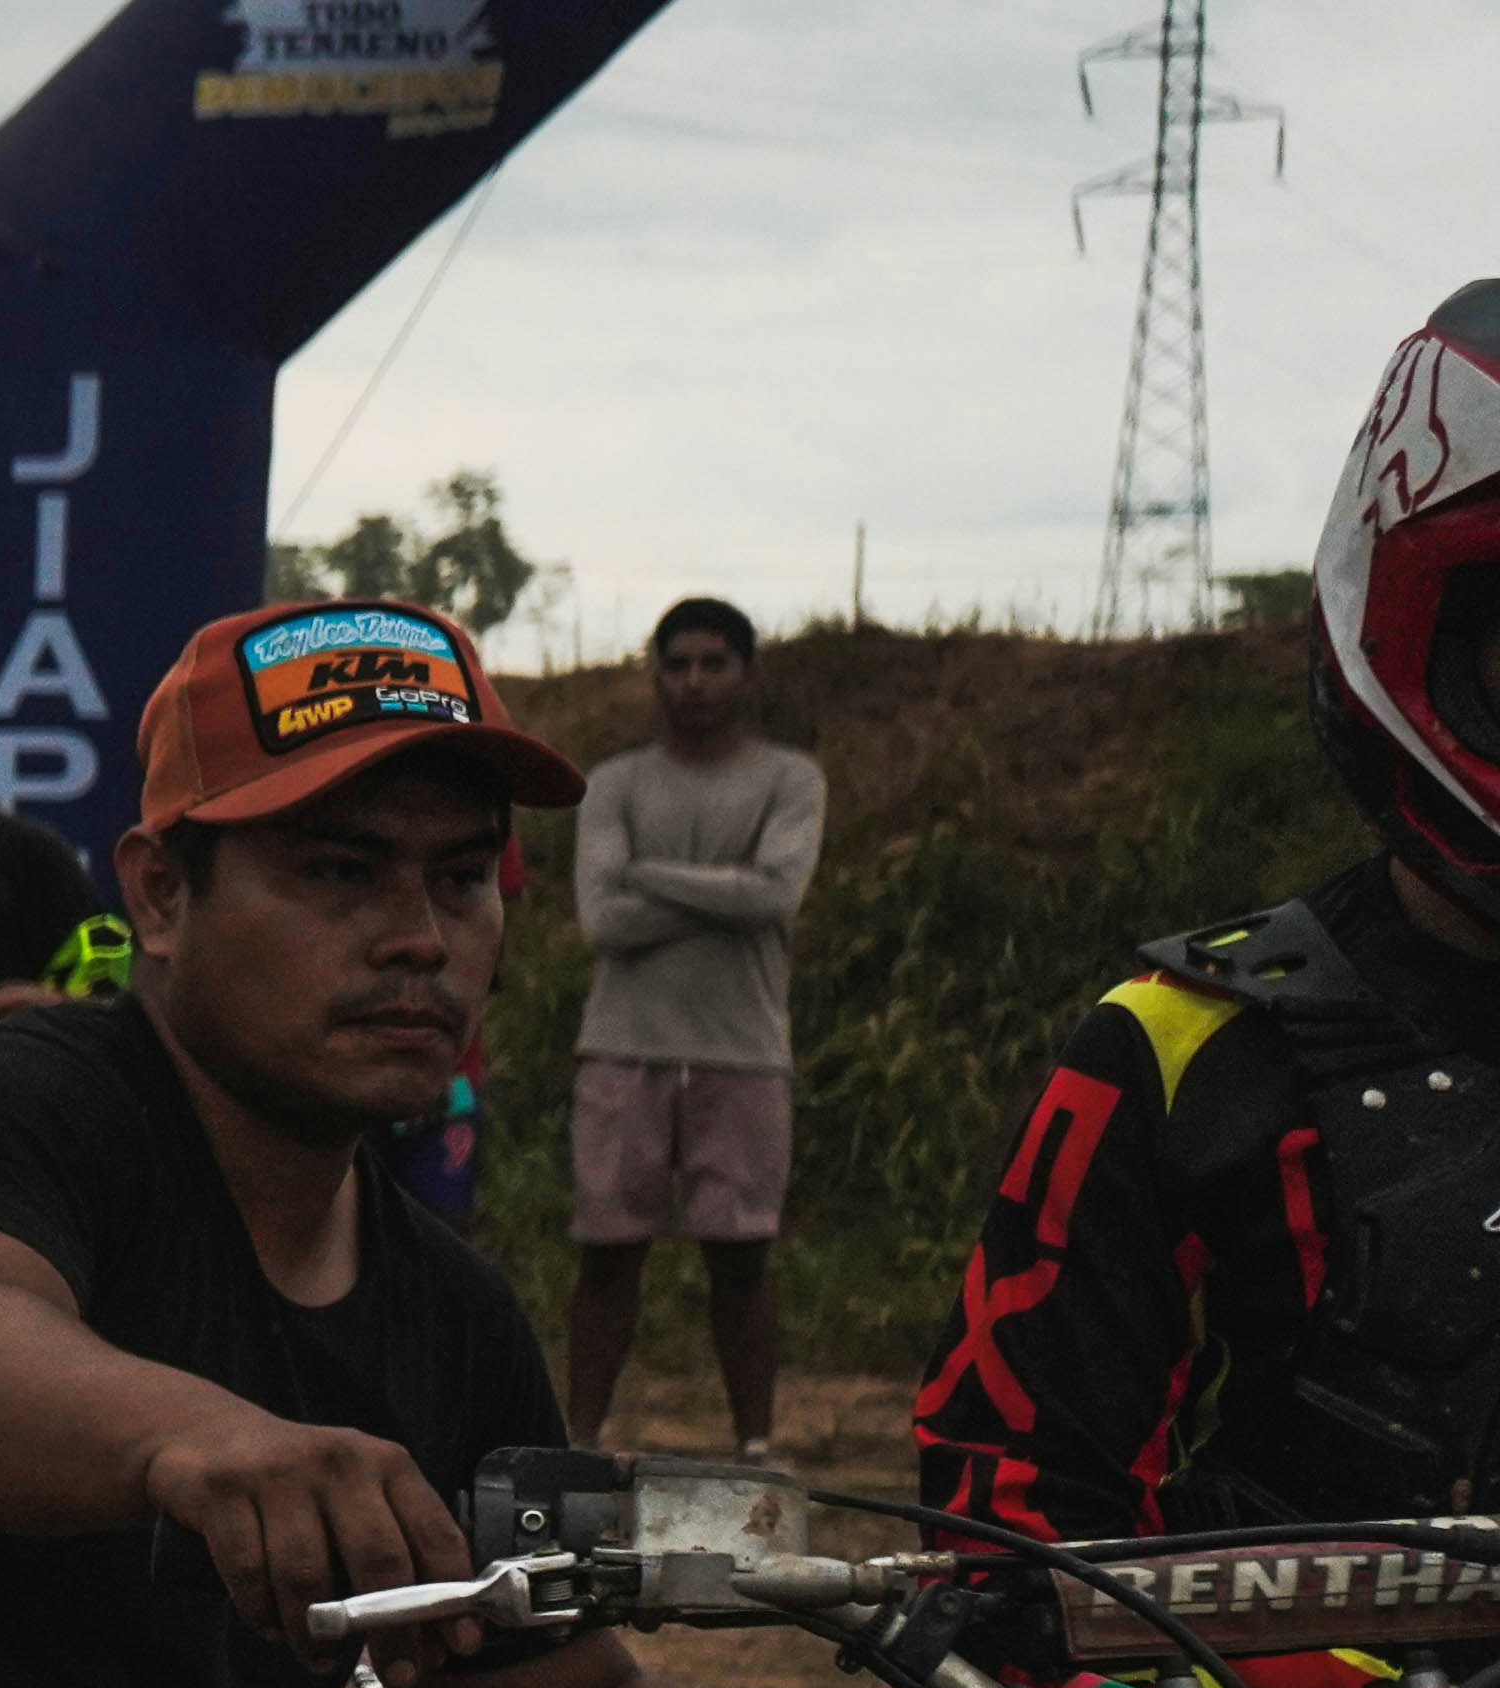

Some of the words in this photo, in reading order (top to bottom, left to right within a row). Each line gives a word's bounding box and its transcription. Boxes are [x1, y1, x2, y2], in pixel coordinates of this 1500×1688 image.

[264, 32, 450, 60] TERRENO
[307, 652, 430, 691] KTM
[278, 696, 353, 736] 4WP
[376, 686, 469, 716] GoPro
